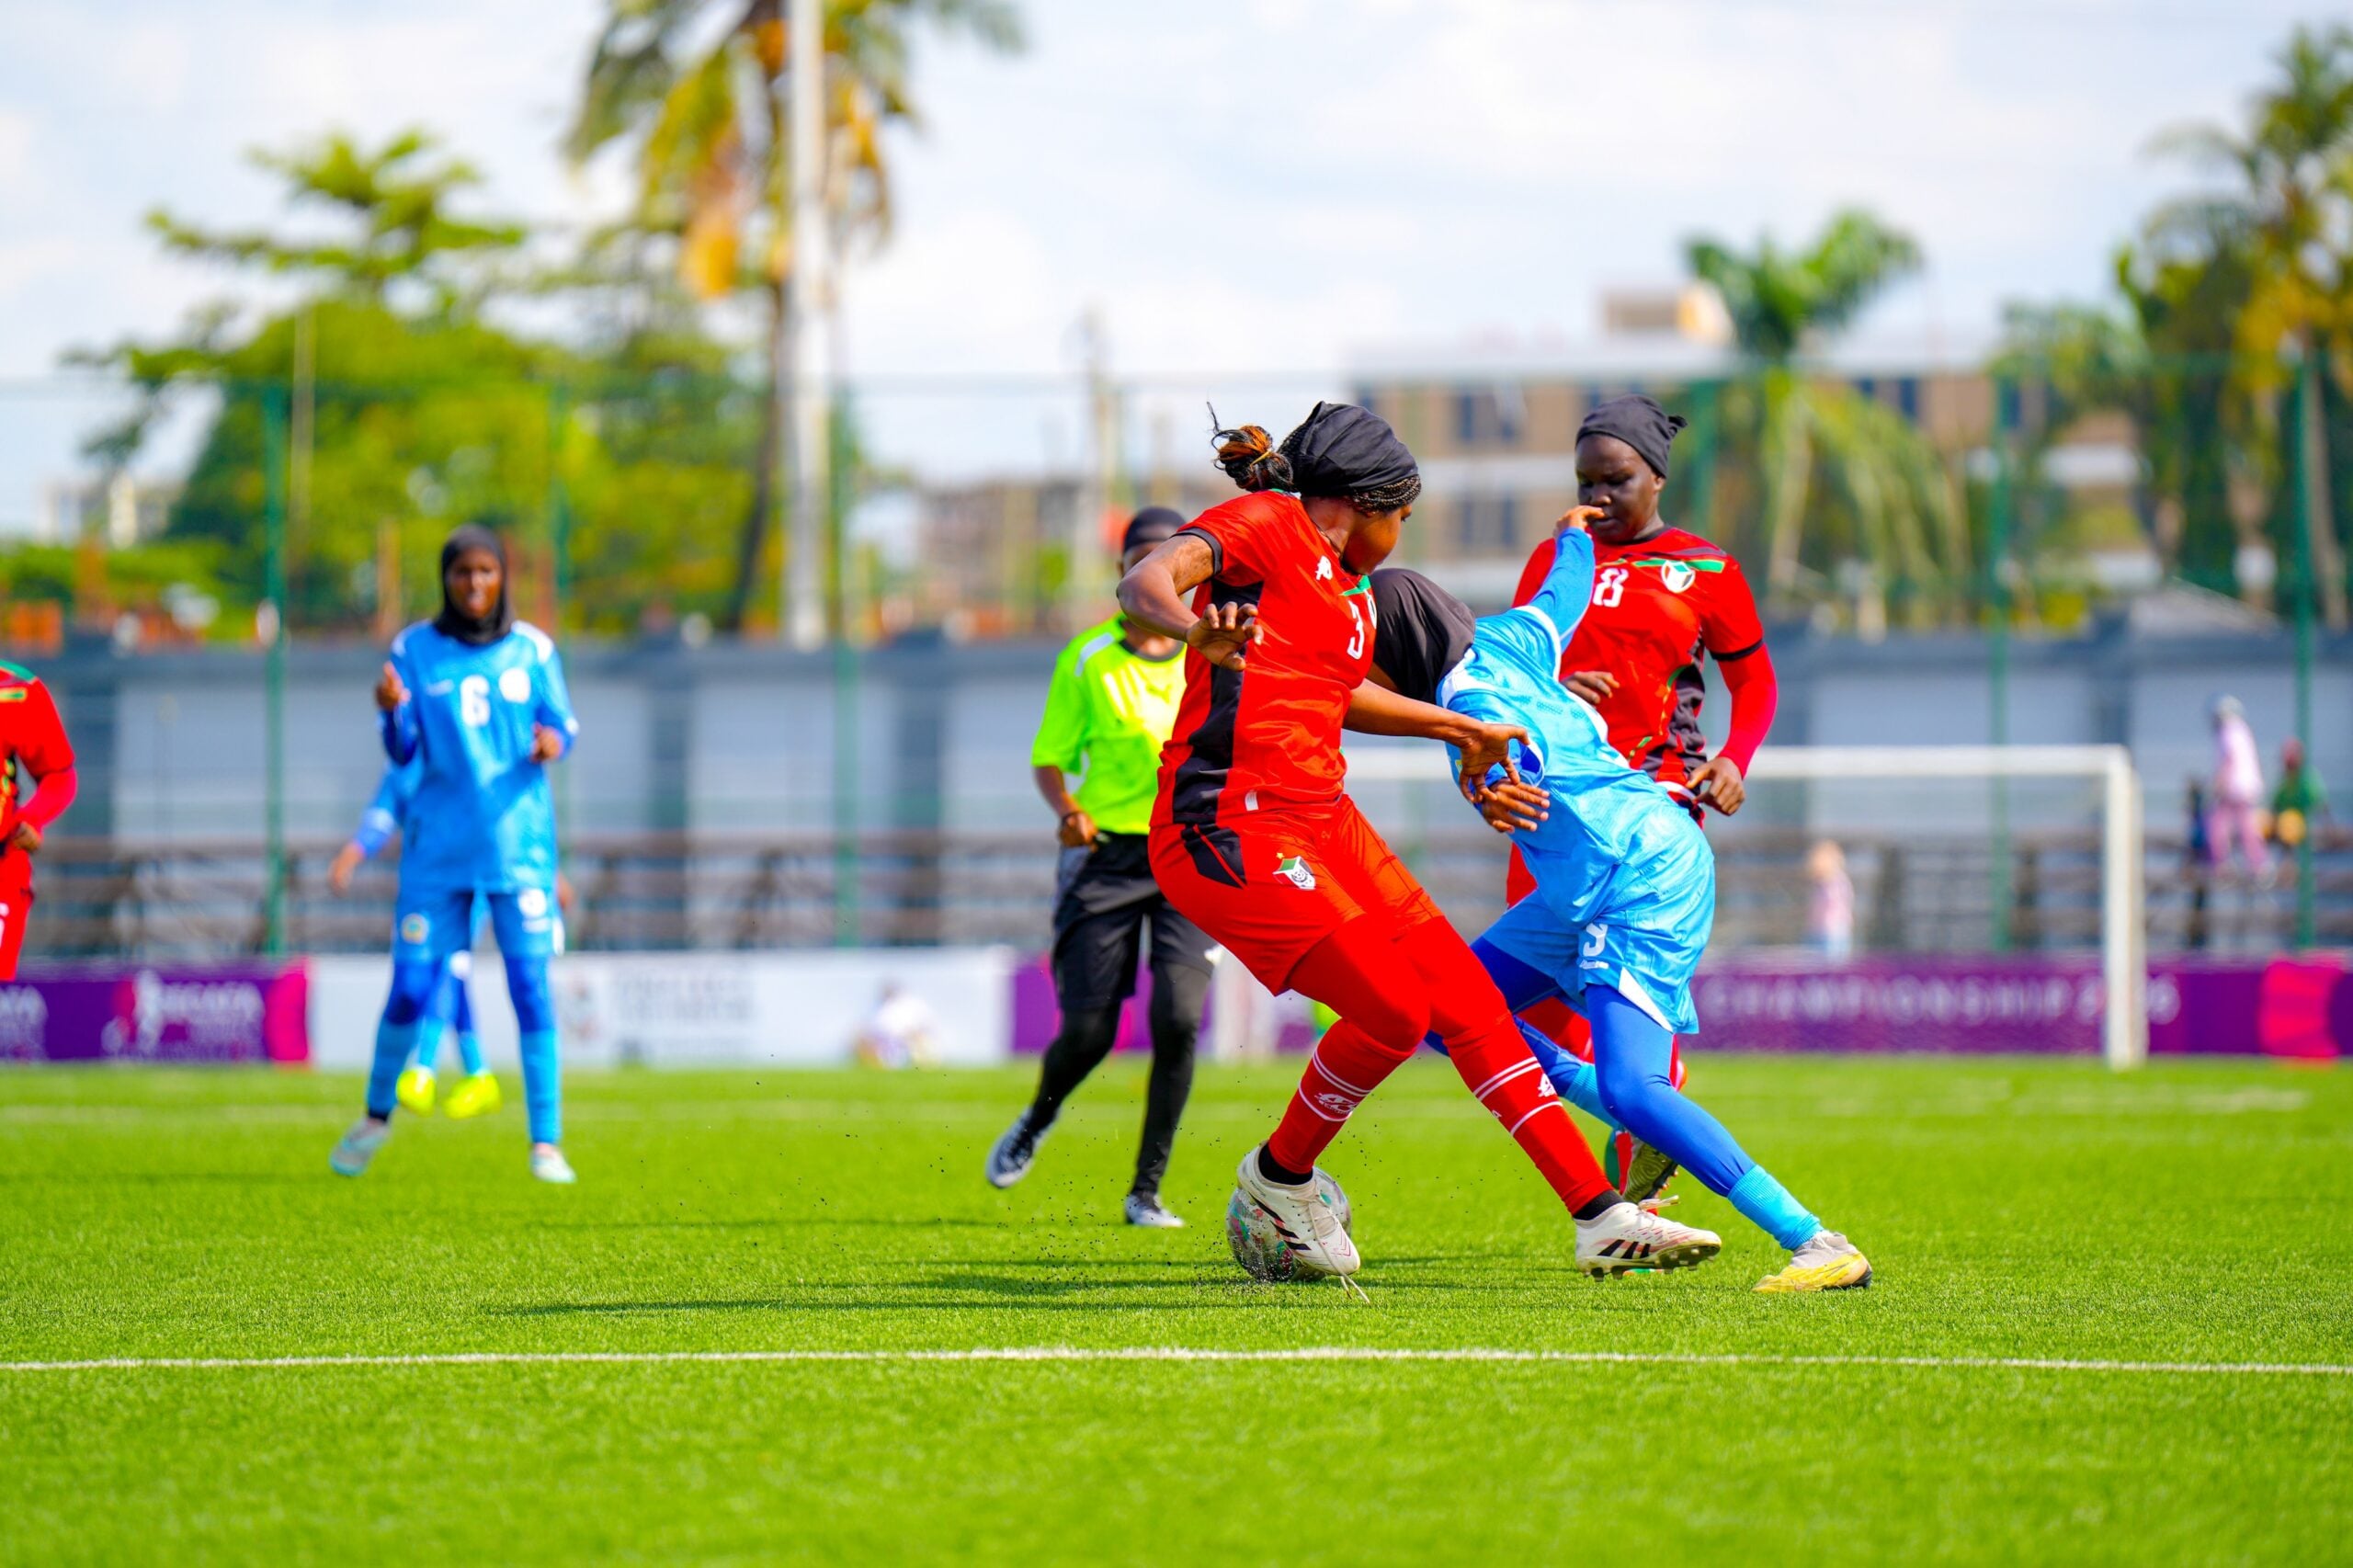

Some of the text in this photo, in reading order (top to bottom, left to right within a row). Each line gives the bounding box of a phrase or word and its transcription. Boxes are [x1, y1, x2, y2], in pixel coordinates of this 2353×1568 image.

[1592, 567, 1629, 608] 8
[1347, 599, 1365, 660] 3
[460, 674, 491, 728] 6
[1699, 974, 2072, 1024] CHAMPIONSHIP
